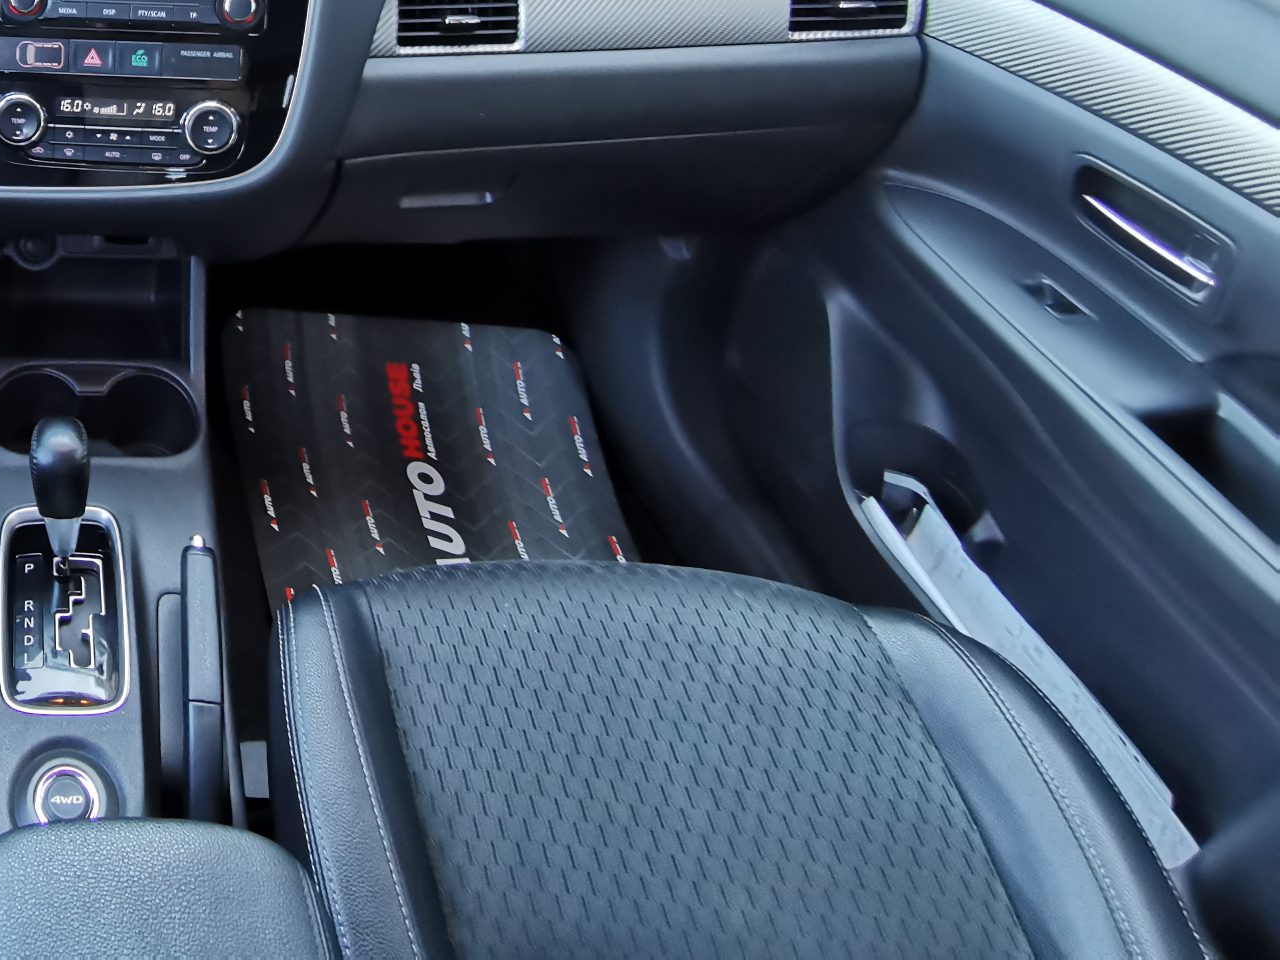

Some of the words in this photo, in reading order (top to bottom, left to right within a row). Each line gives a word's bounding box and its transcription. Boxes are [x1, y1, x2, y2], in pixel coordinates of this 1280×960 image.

[58, 7, 77, 15] MEDIA
[131, 54, 148, 62] ECO
[203, 125, 219, 133] TEMP
[410, 363, 424, 393] Львів
[517, 380, 529, 406] AUTO
[385, 361, 425, 460] HOUSE
[340, 411, 351, 435] AUTO
[417, 401, 438, 461] Автосалон
[479, 425, 492, 451] AUTO
[574, 435, 589, 462] AUTO
[302, 462, 314, 485] AUTO
[264, 494, 276, 518] AUTO
[546, 496, 563, 523] AUTO
[366, 516, 380, 541] AUTO
[24, 563, 34, 574] P
[24, 600, 34, 612] R
[24, 617, 34, 628] N
[24, 635, 34, 646] D
[50, 795, 83, 804] 4WD
